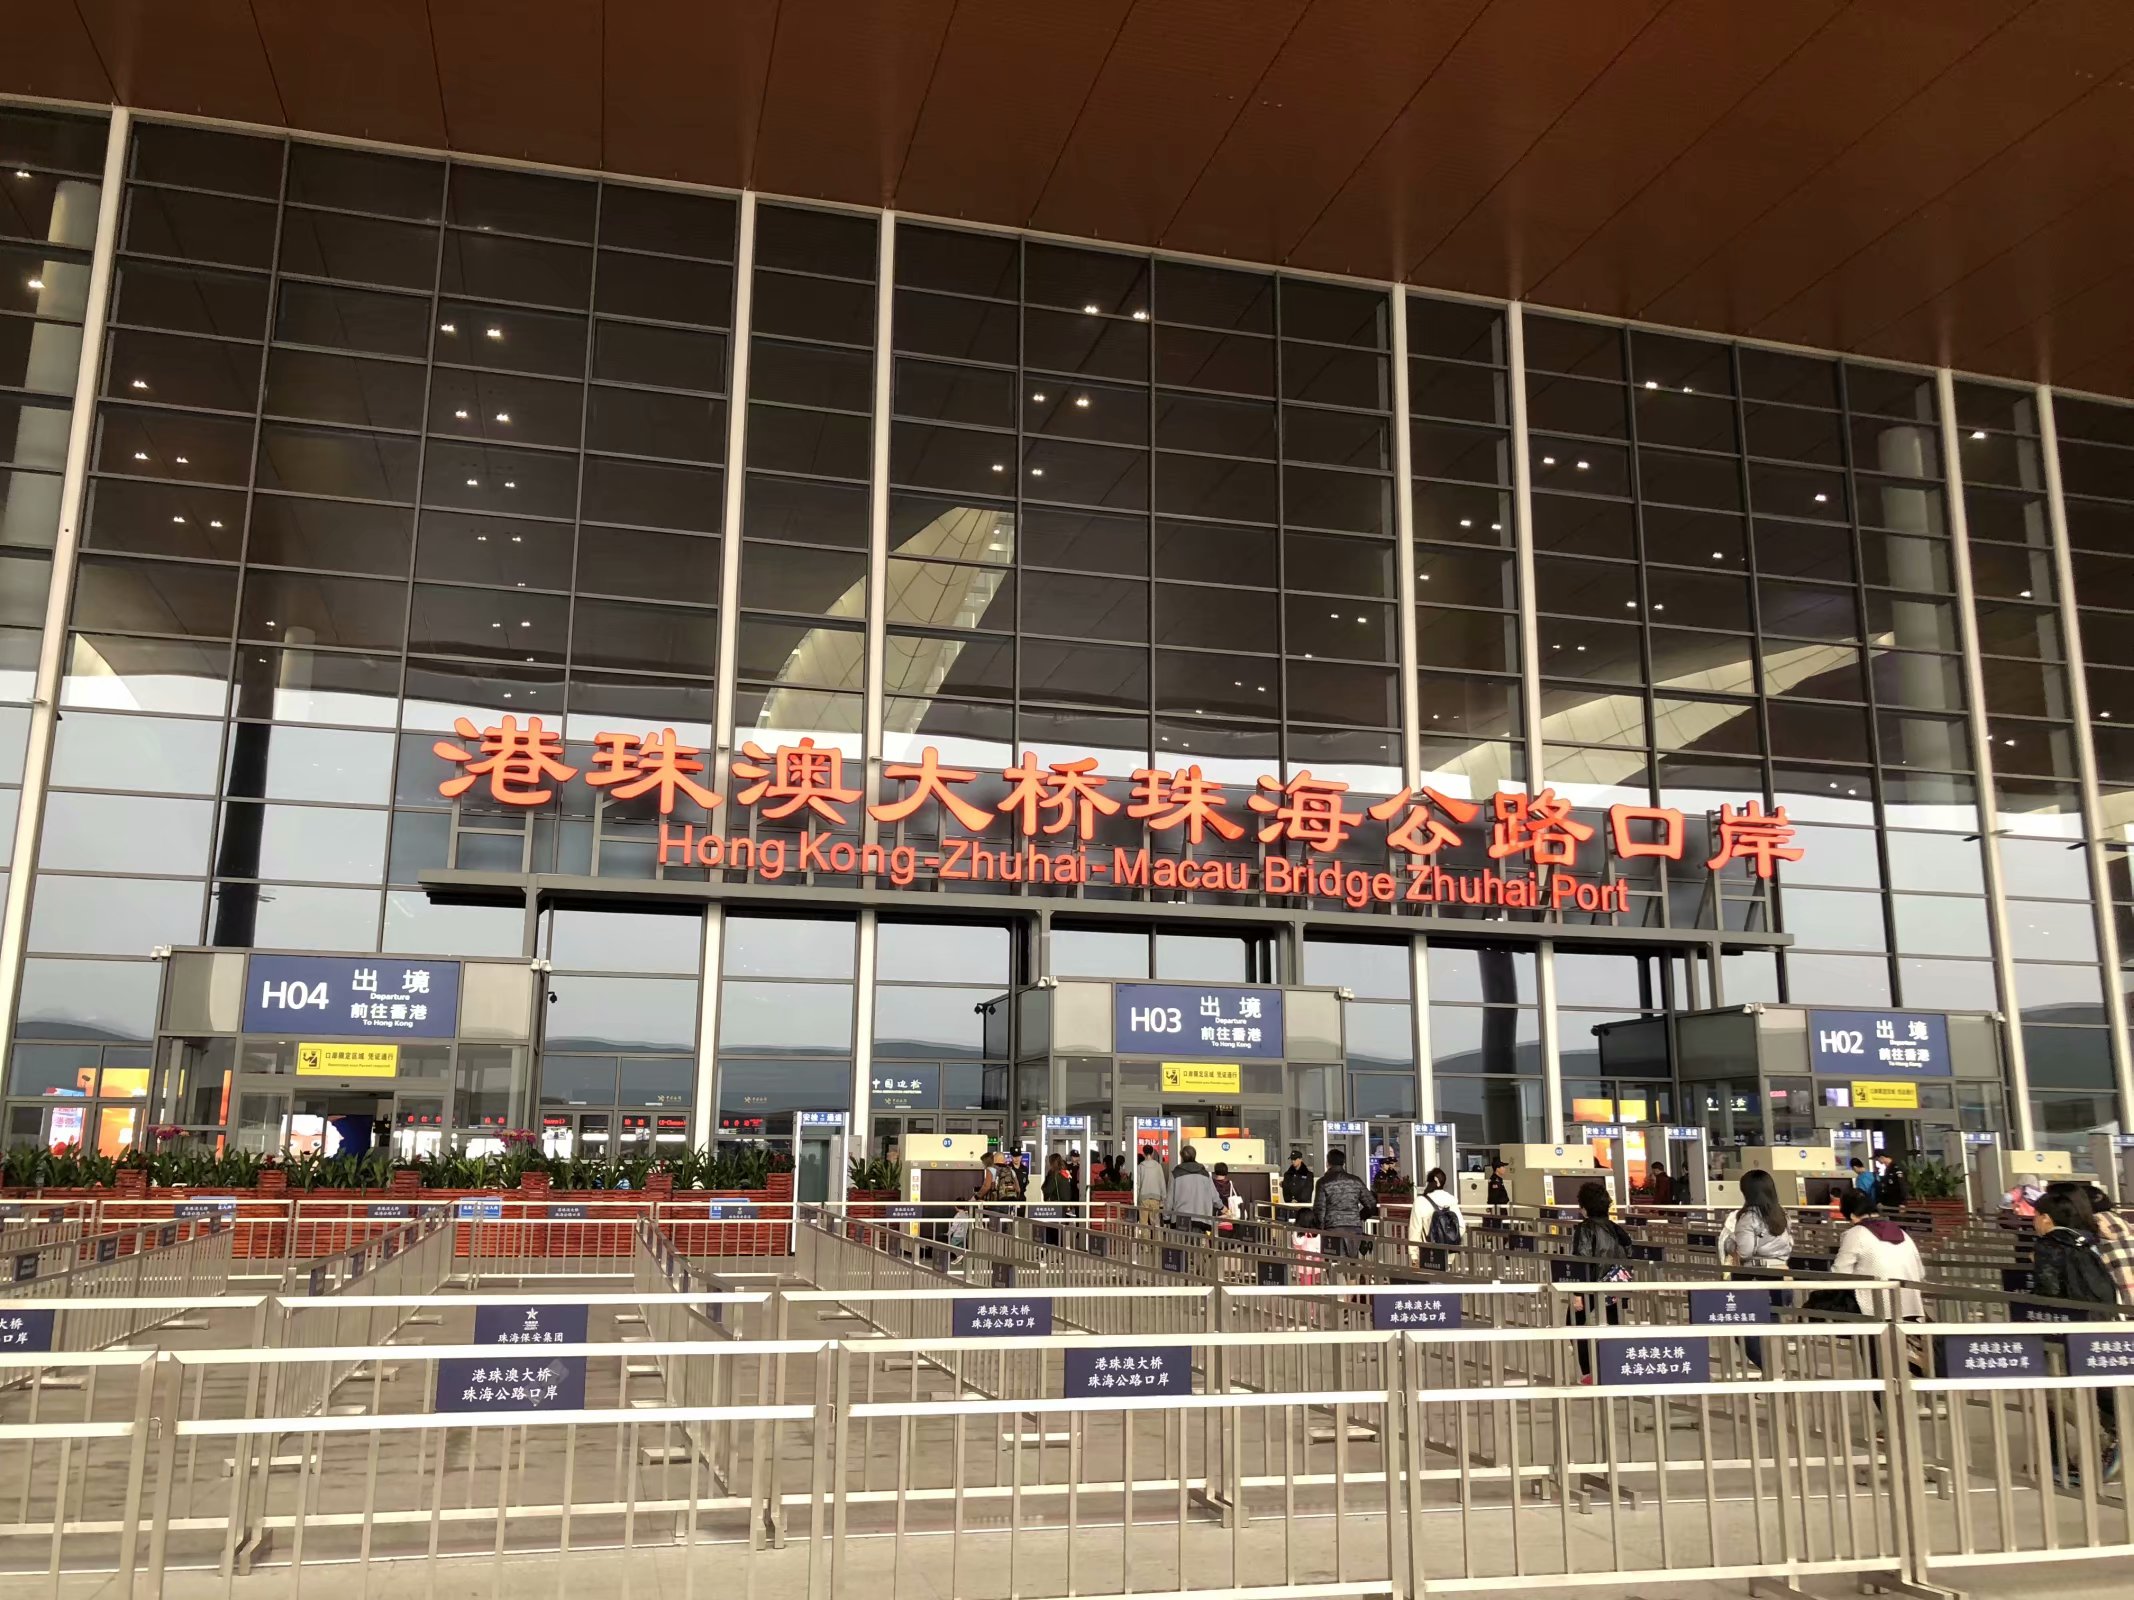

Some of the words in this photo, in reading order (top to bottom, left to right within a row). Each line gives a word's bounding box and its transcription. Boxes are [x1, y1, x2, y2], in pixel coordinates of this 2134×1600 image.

[434, 716, 1804, 880] 港珠澳大桥珠海公路口岸
[658, 824, 787, 879] Hong
[1265, 856, 1396, 908] Bridge
[1405, 863, 1538, 908] Zhuhai
[1552, 874, 1631, 913] Port
[262, 980, 330, 1010] H04
[370, 993, 411, 1001] Departure
[351, 1002, 428, 1021] 前往香港
[374, 1019, 393, 1027] Hong
[394, 1019, 413, 1028] Kong
[1131, 1006, 1182, 1033] H03
[1215, 1017, 1247, 1025] Departure
[1201, 1026, 1262, 1042] 前往香港
[1820, 1030, 1865, 1054] H02
[977, 1305, 1030, 1316] 港珠澳大桥
[1395, 1300, 1442, 1311] 港珠澳大桥
[971, 1318, 1035, 1329] 珠海公路口岸
[1390, 1312, 1446, 1323] 珠海公路口岸
[1708, 1313, 1756, 1323] 珠海保安集团
[498, 1332, 564, 1344] 珠海保安集团
[1626, 1346, 1685, 1360] 港珠澳大桥
[1969, 1341, 2024, 1355] 港珠澳大桥
[1094, 1357, 1164, 1371] 港珠澳大桥
[1620, 1361, 1692, 1376] 珠海公路口岸
[1965, 1356, 2030, 1370] 珠海公路口岸
[472, 1367, 552, 1384] 港珠澳大桥
[1087, 1373, 1169, 1388] 珠海公路口岸
[462, 1385, 558, 1403] 珠海公路口岸
